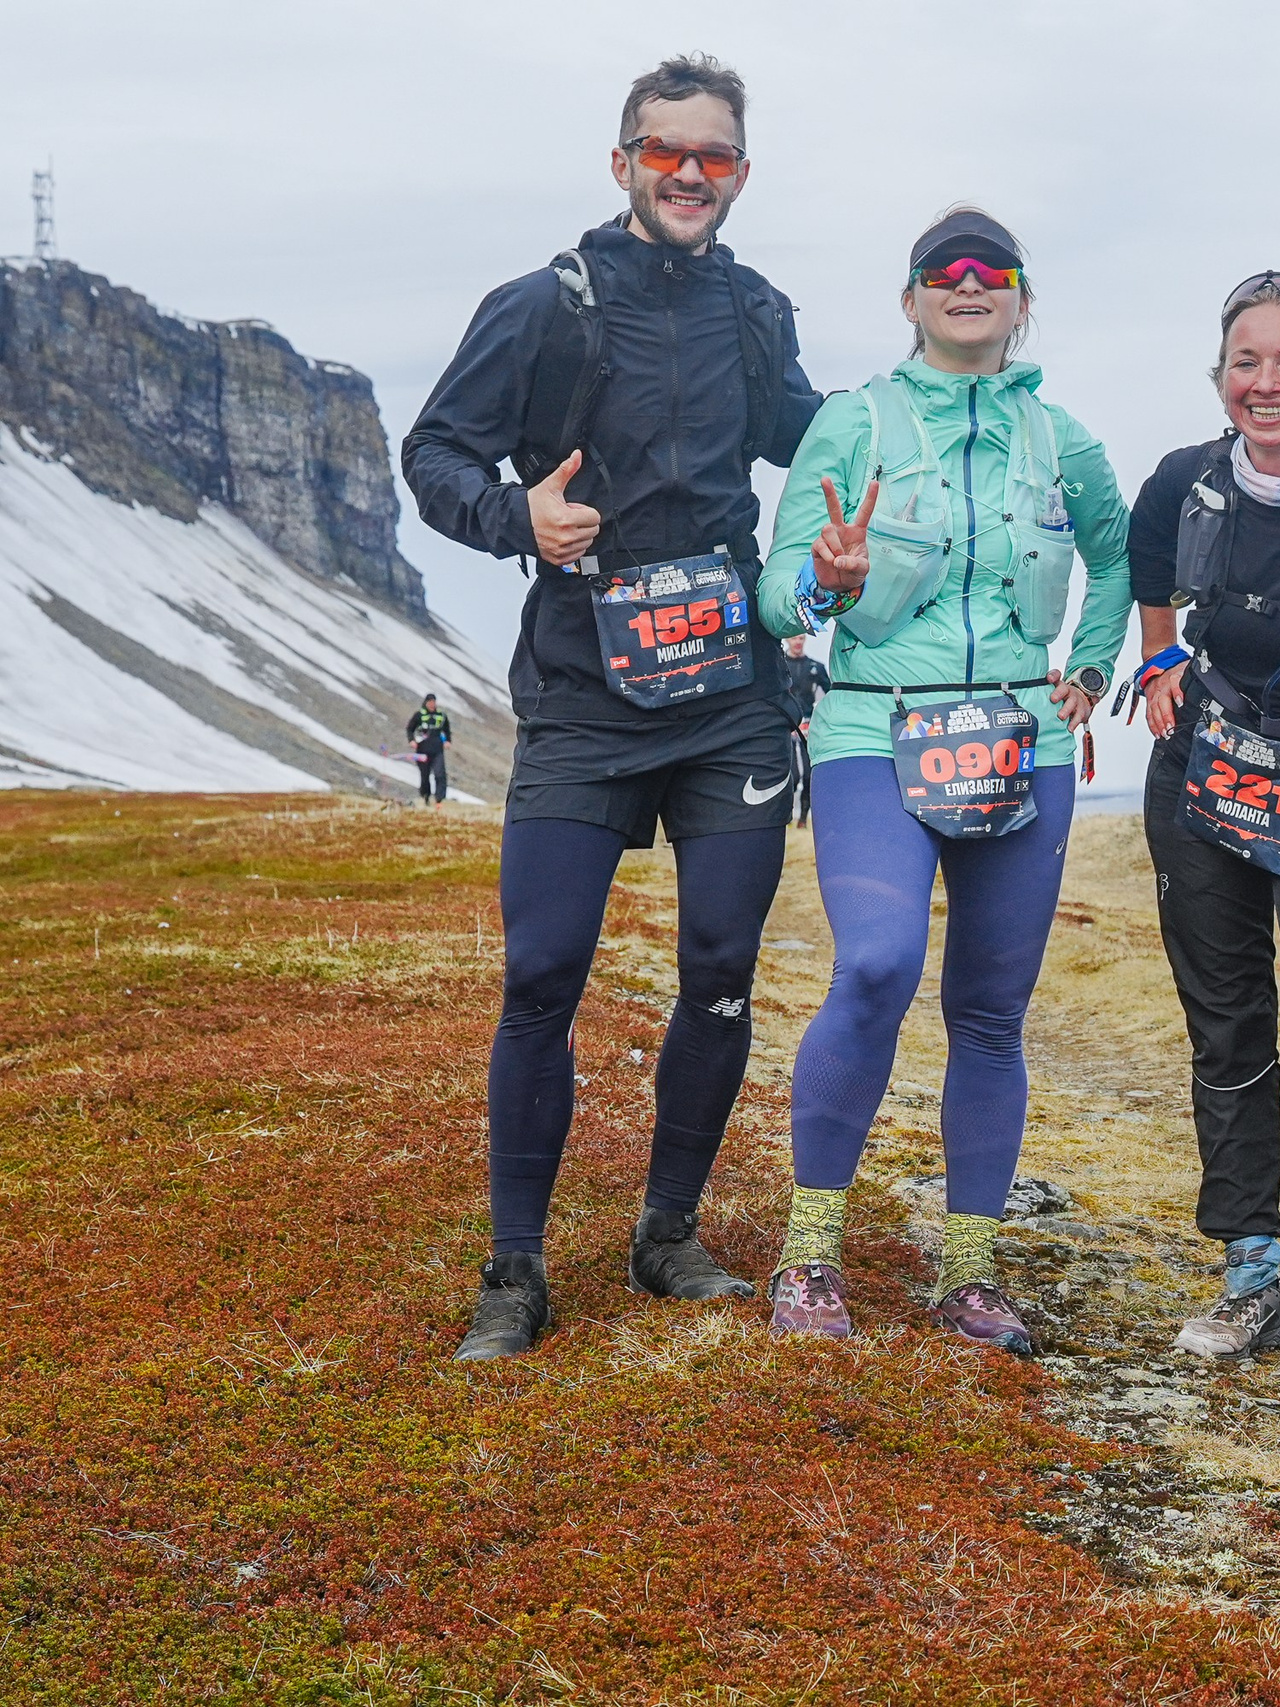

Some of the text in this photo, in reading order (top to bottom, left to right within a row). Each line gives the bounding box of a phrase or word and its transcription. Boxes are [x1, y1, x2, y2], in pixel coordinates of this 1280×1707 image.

[649, 576, 688, 589] GRAND
[651, 569, 685, 581] ULTRA
[714, 569, 727, 581] 50
[649, 582, 692, 597] ESCAPE
[628, 598, 722, 649] 155
[731, 606, 741, 624] 2
[656, 638, 705, 664] МИХАИЛ
[947, 715, 988, 726] GRAND
[949, 707, 984, 719] ULTRA
[1017, 711, 1029, 723] 50
[947, 722, 990, 735] ESCAPE
[1239, 745, 1276, 762] GRAND
[1242, 739, 1274, 756] ULTRA
[920, 739, 1020, 783] 090
[1022, 751, 1029, 769] 2
[1235, 750, 1276, 770] ESCAPE
[944, 778, 1006, 796] ЕЛИЗАВЕТА
[1216, 798, 1270, 828] ИОЛАНТА
